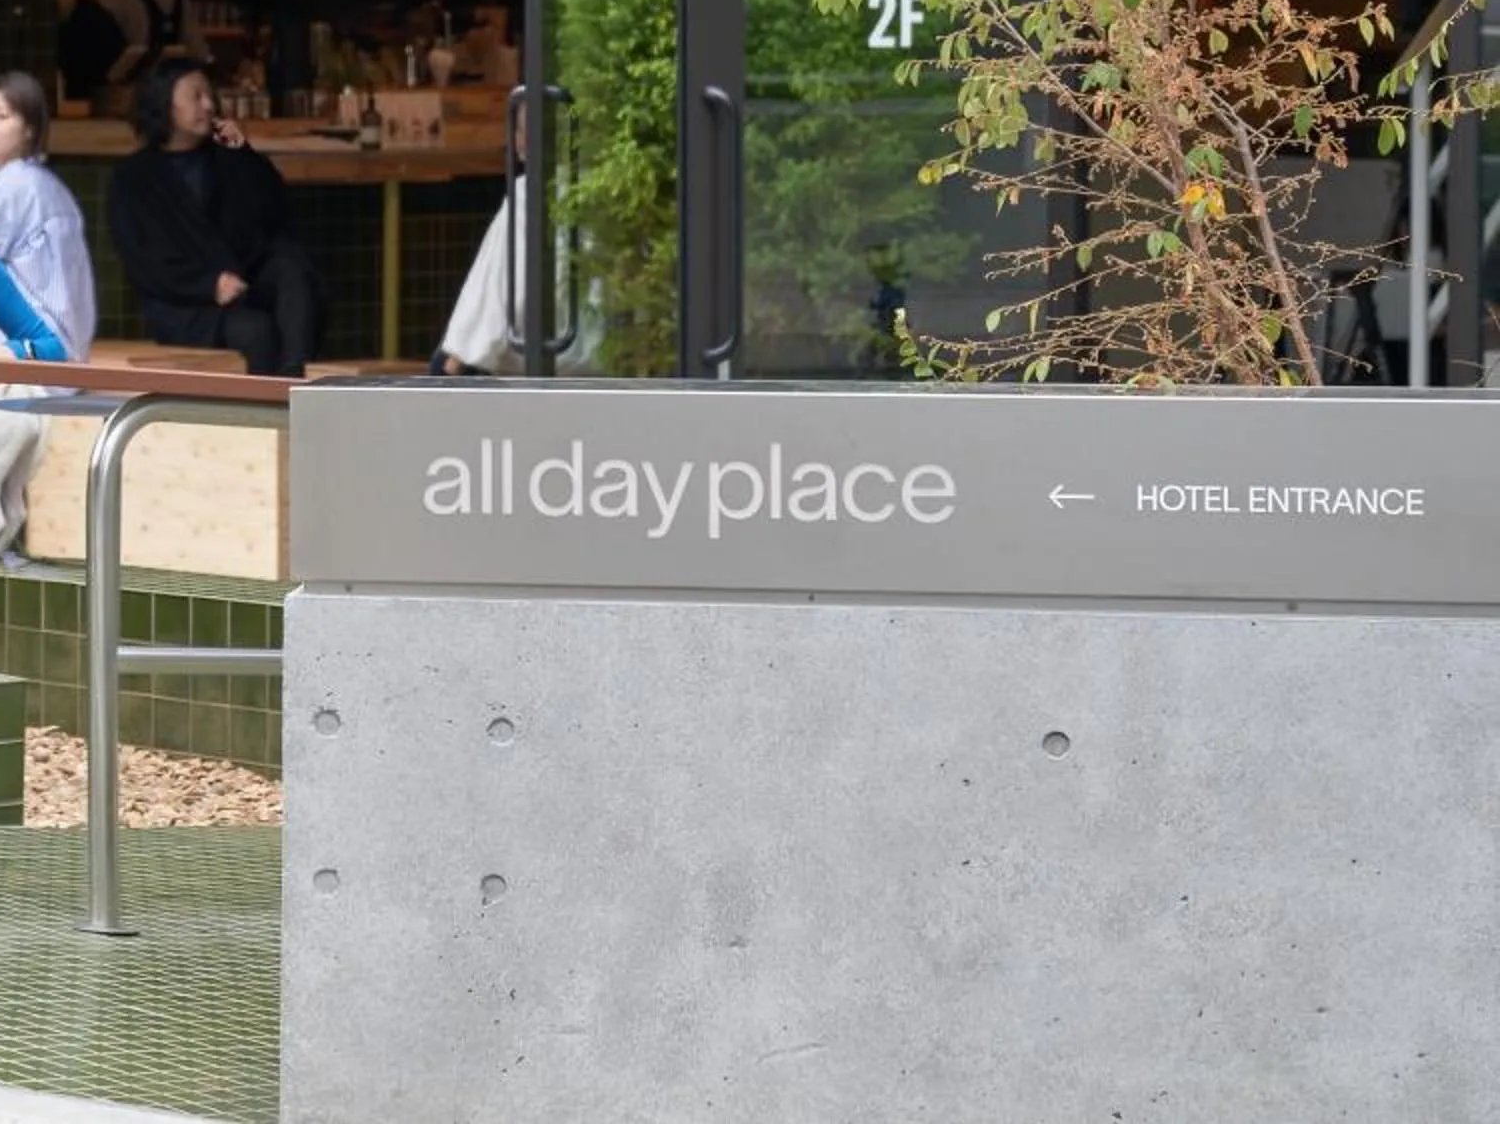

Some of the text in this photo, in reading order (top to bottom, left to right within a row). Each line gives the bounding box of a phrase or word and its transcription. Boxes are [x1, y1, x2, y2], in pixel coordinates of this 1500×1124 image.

[422, 437, 958, 540] all day place
[1136, 483, 1426, 516] HOTEL ENTRANCE
